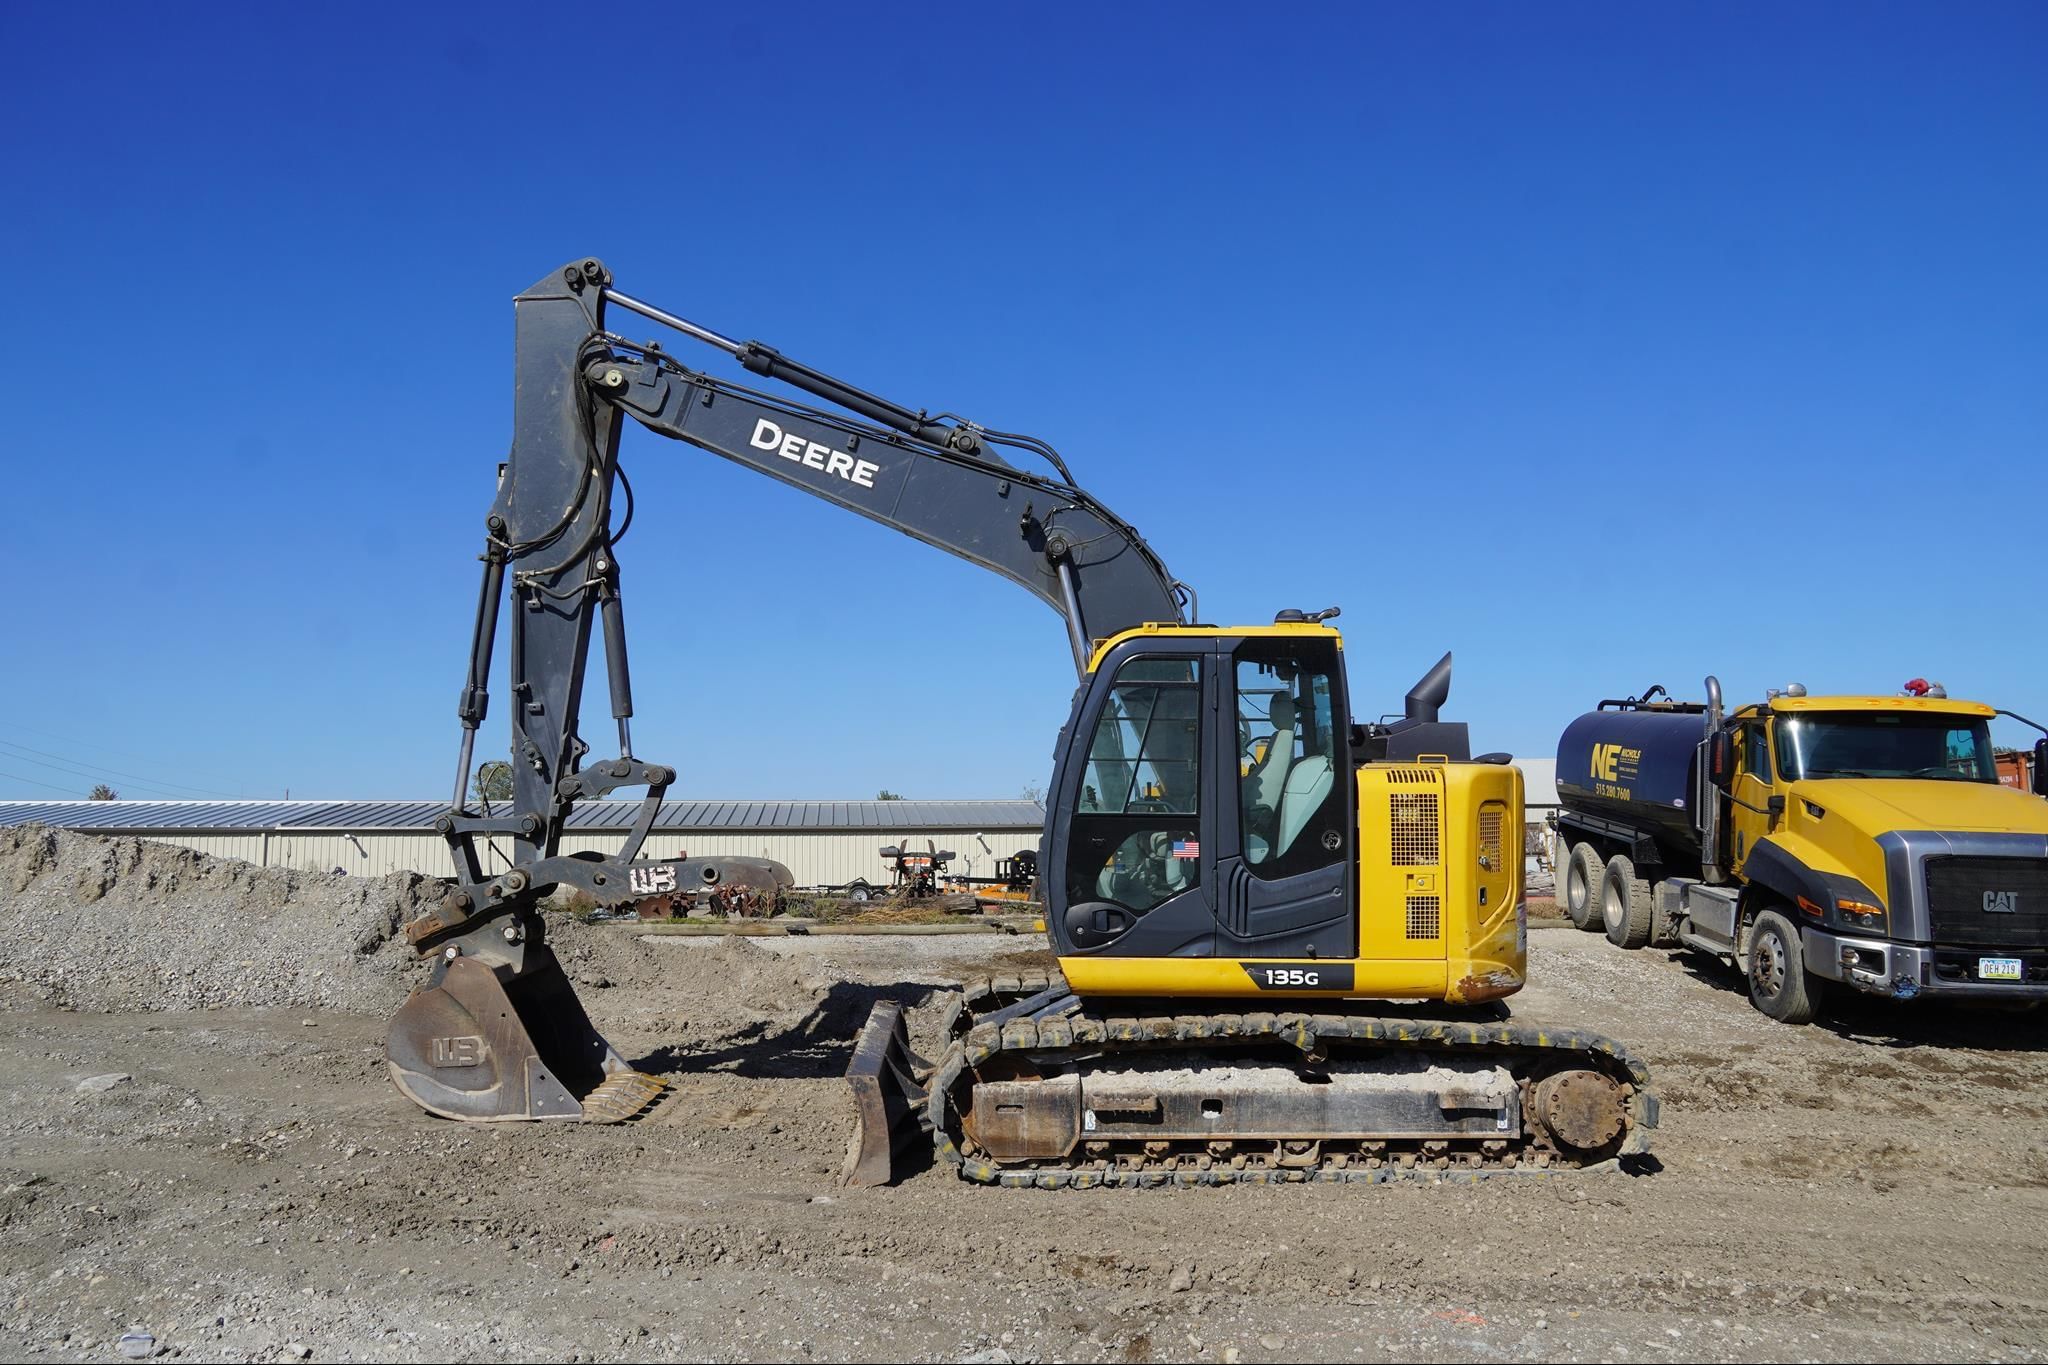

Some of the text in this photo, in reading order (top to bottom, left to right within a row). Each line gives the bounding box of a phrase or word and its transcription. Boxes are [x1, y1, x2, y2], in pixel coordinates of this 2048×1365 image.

[750, 418, 880, 488] DEERE
[1590, 743, 1622, 782] NE
[1595, 783, 1631, 801] 515.280.7600
[1982, 891, 2018, 913] CAT
[1265, 969, 1319, 985] 135G
[2001, 964, 2016, 975] 219
